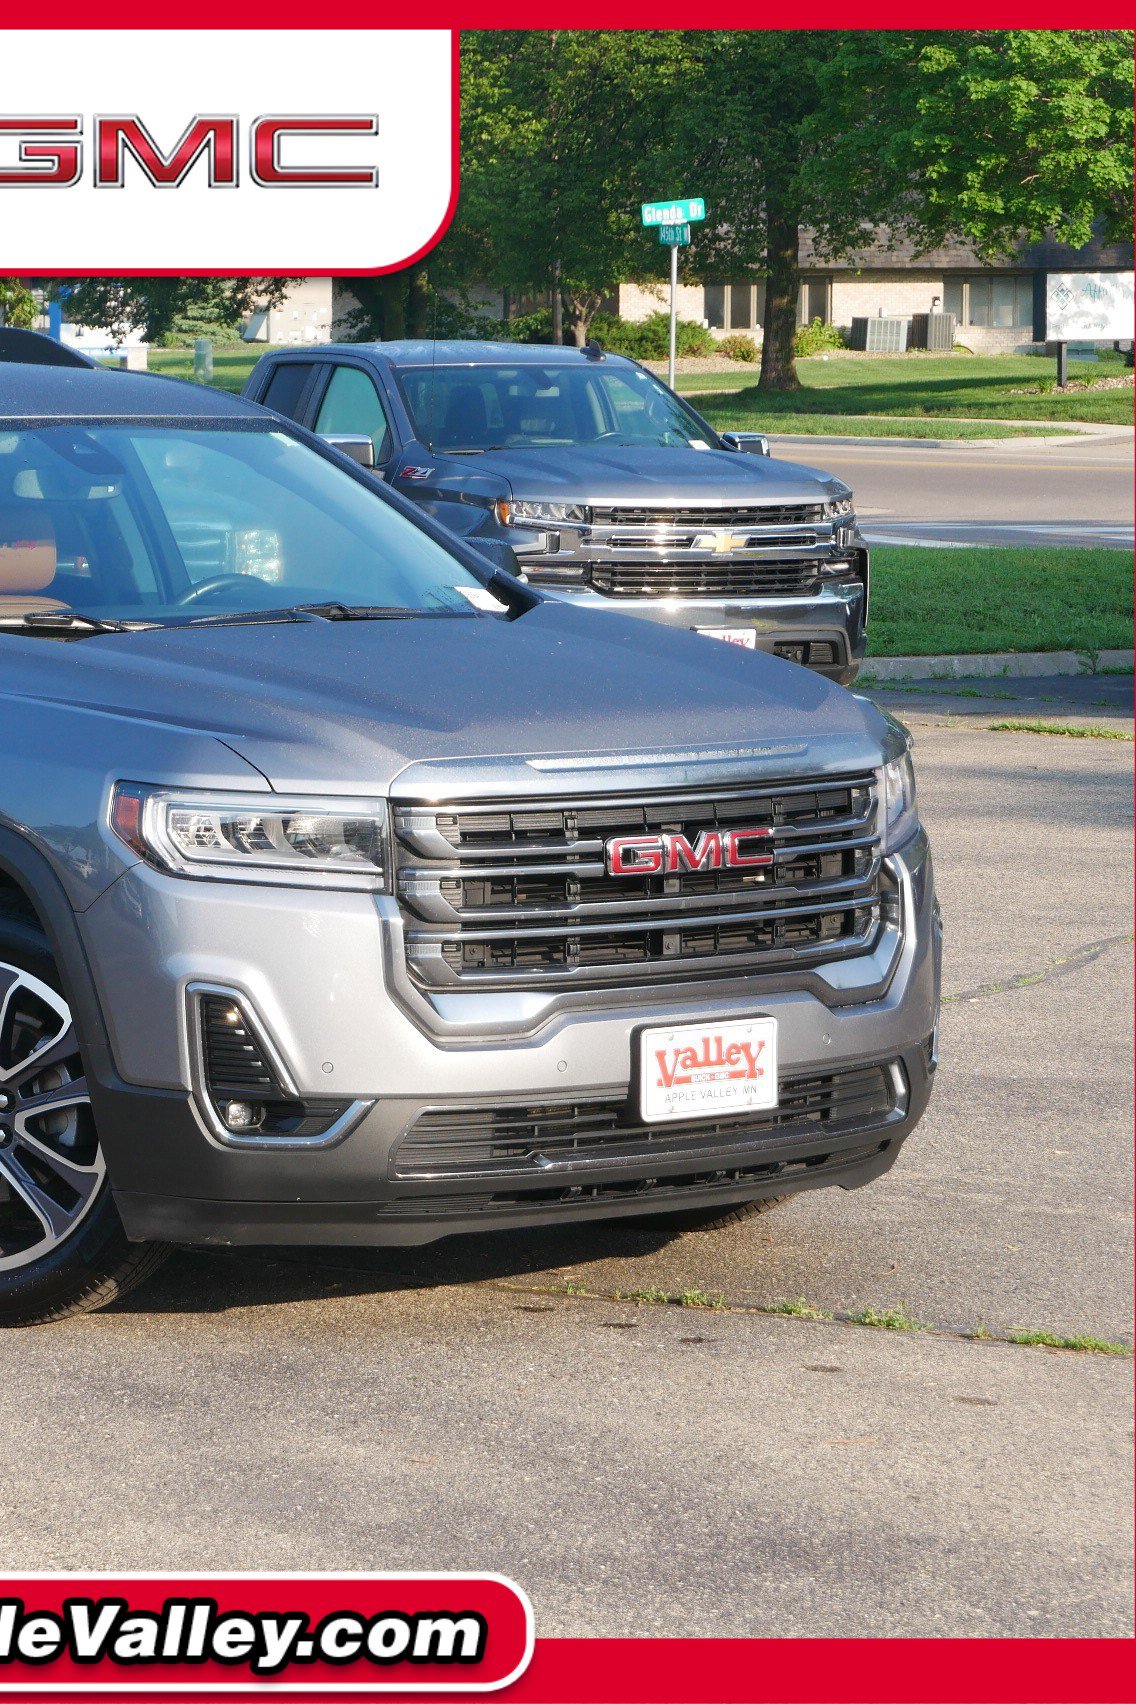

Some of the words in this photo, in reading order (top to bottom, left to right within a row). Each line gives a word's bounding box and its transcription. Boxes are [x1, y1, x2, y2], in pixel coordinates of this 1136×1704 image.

[644, 205, 683, 223] Glenda
[689, 201, 703, 218] Dr
[721, 635, 751, 647] lley
[606, 827, 773, 876] GMC
[655, 1035, 765, 1087] Valley
[665, 1090, 697, 1103] APPLE
[700, 1085, 738, 1099] VALLEY
[742, 1085, 757, 1095] MN
